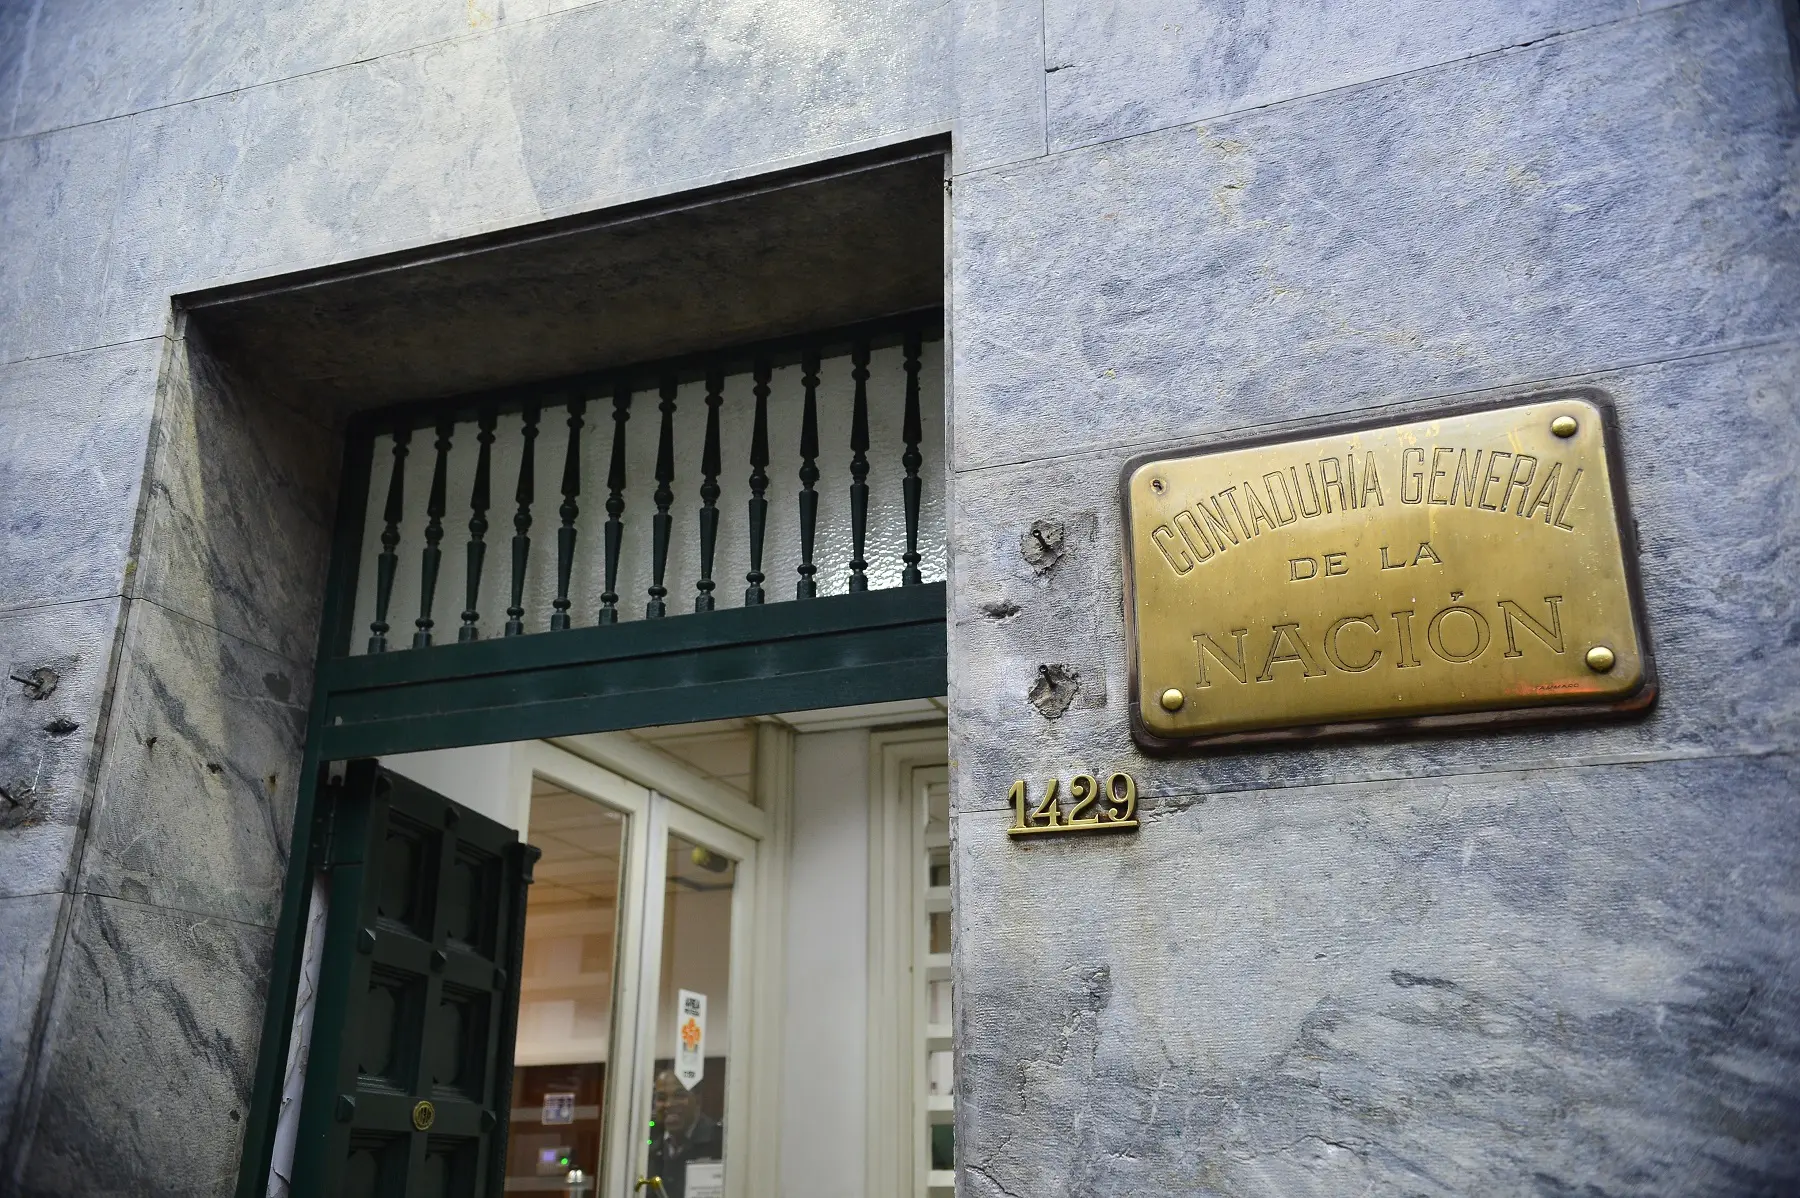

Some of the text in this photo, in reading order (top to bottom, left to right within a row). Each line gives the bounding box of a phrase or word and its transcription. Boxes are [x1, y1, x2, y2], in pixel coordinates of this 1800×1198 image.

[1152, 446, 1585, 576] CONTADURÍA GENERAL
[1289, 542, 1442, 582] DE LA
[1192, 592, 1564, 687] NACIÓN
[1008, 773, 1136, 829] 1429
